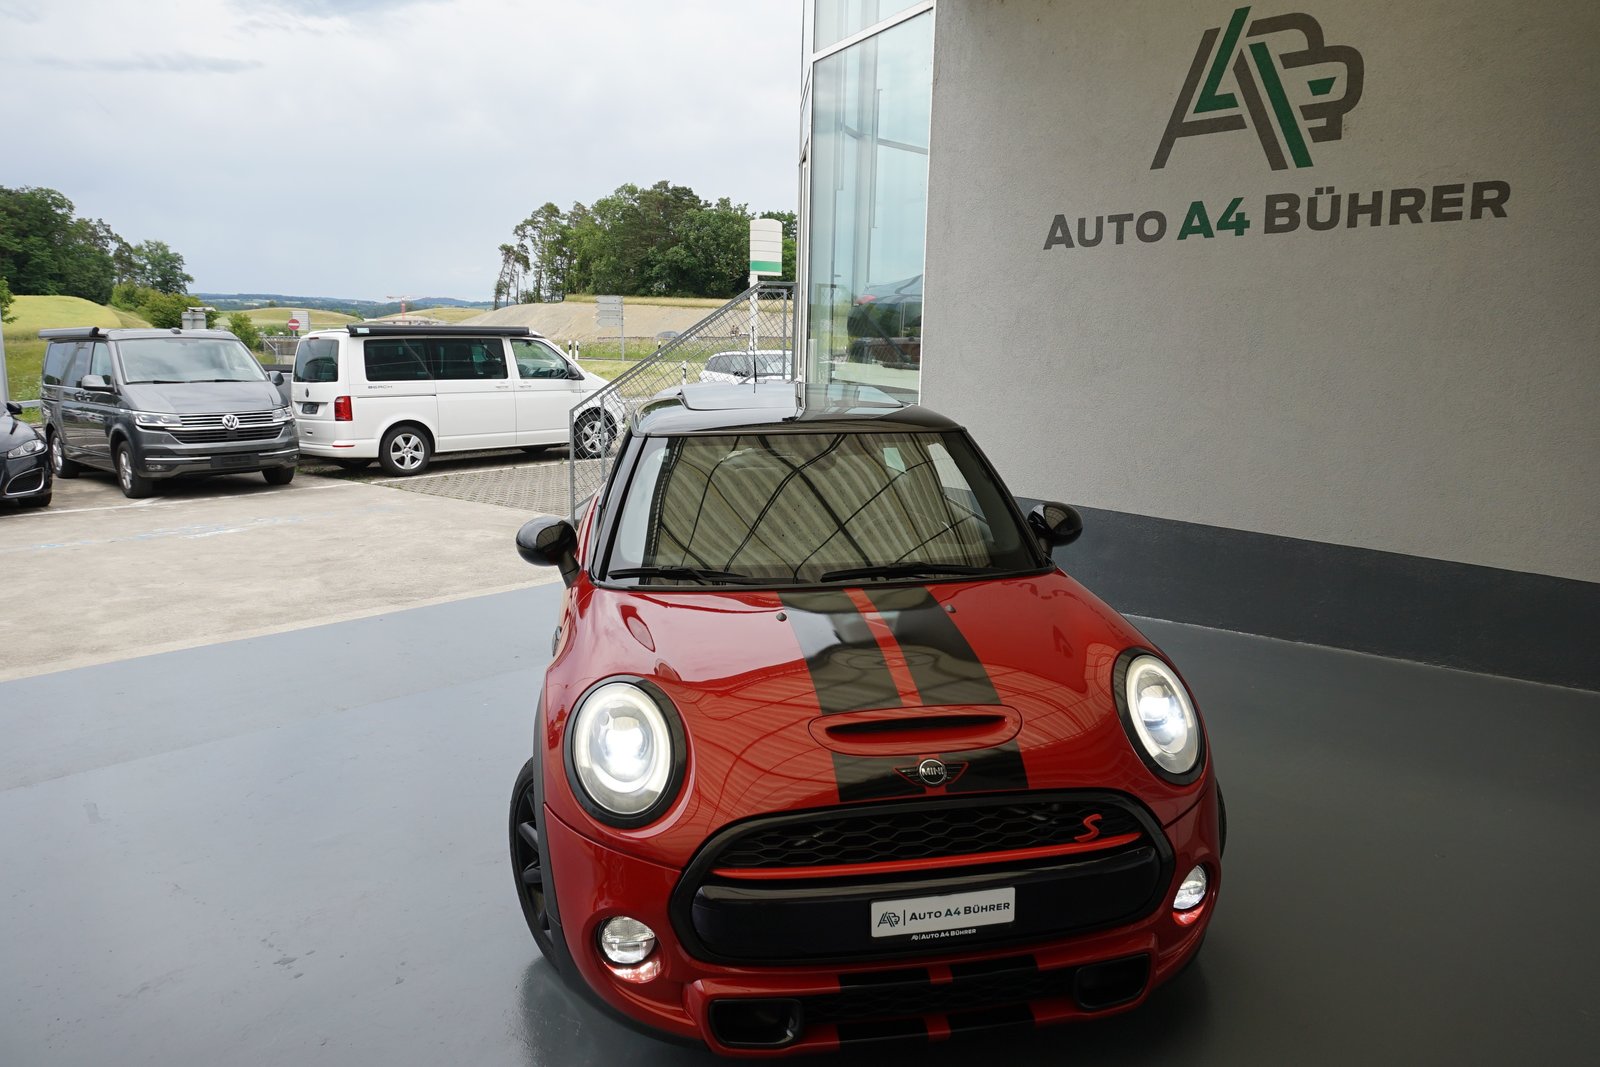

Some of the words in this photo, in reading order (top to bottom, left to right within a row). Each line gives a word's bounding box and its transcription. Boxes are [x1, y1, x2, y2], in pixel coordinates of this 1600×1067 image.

[1043, 210, 1168, 250] AUTO
[1176, 197, 1251, 241] A4
[1263, 180, 1512, 235] BÜHRER
[921, 766, 944, 776] MINI
[909, 911, 942, 921] AUTO
[944, 907, 961, 918] A4
[963, 902, 1011, 915] BÜHRER
